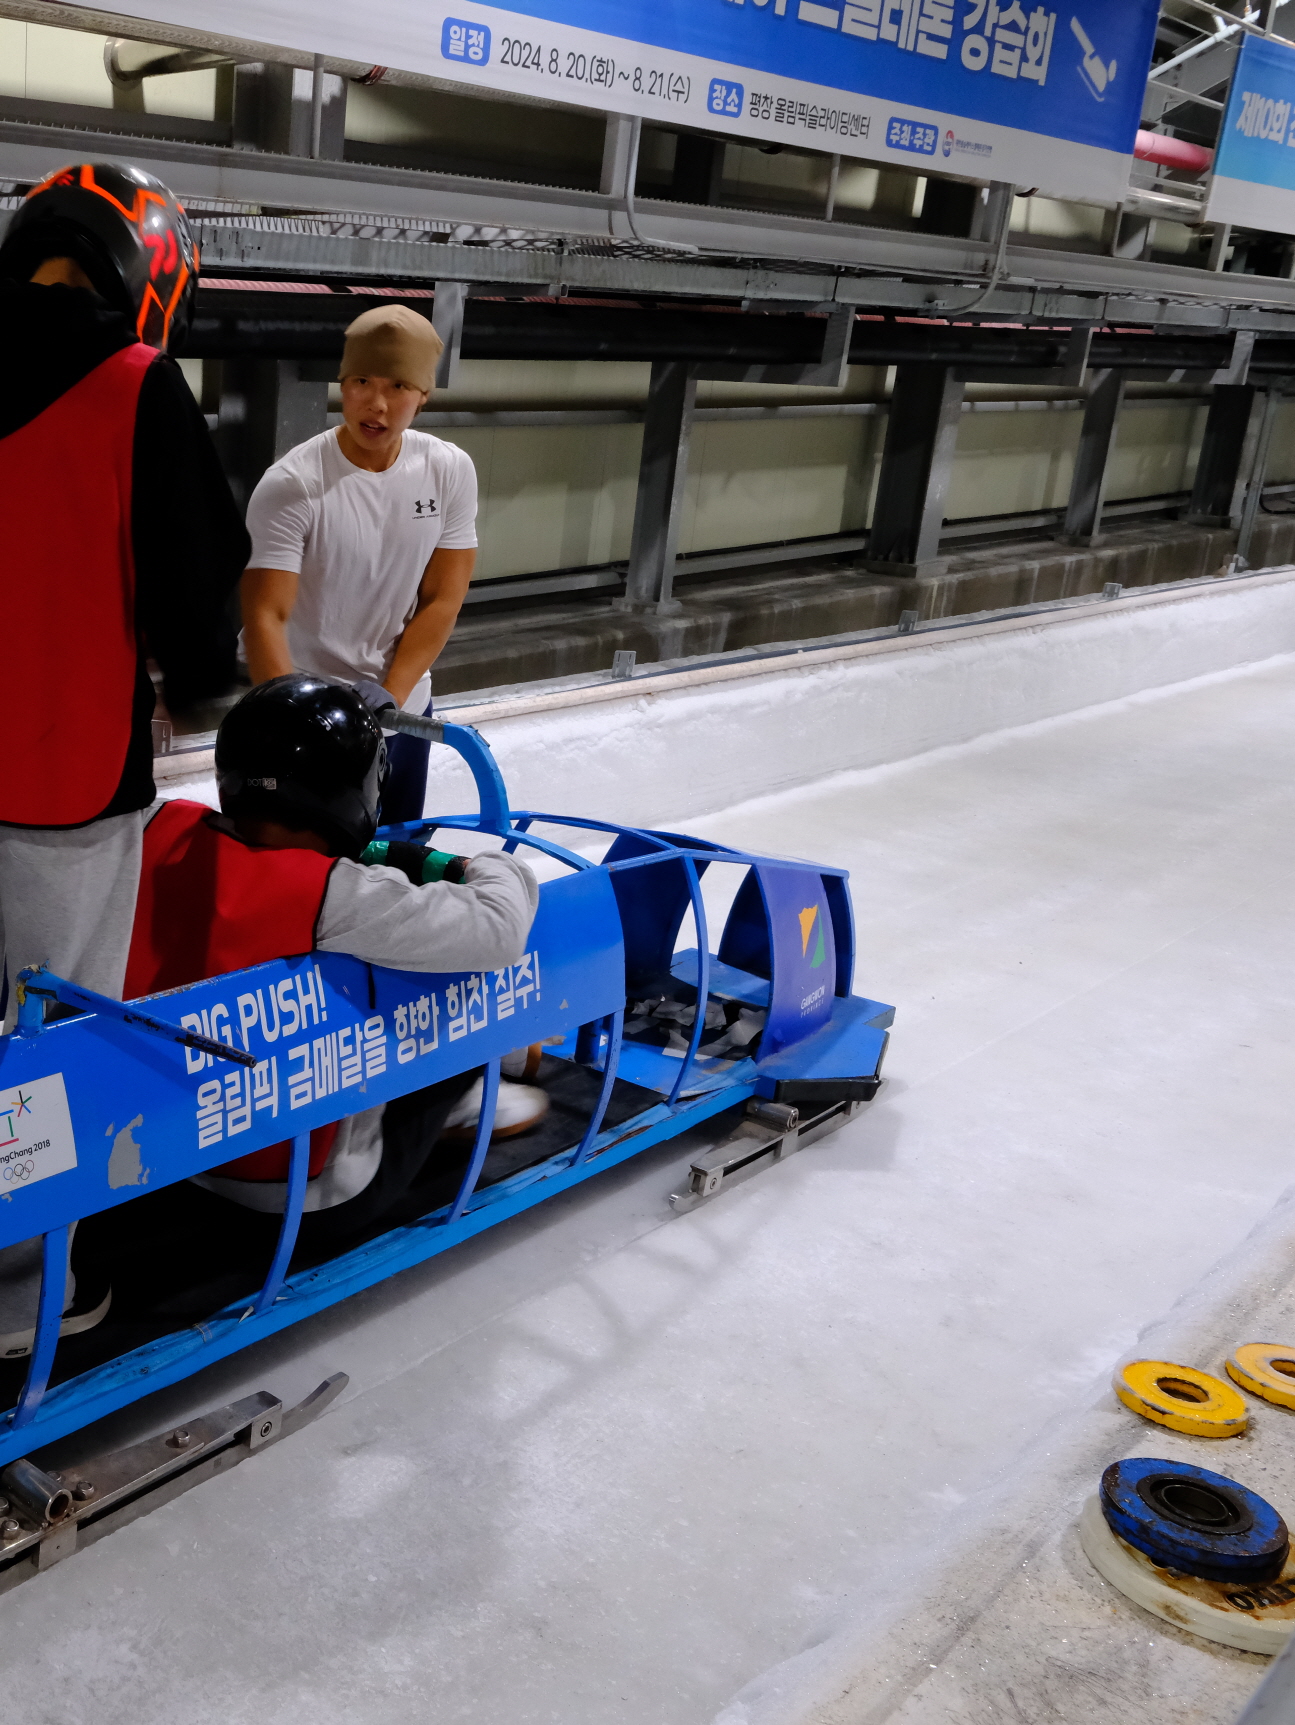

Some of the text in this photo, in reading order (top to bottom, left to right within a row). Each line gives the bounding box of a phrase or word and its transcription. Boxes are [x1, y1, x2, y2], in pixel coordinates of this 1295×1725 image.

[448, 24, 485, 61] 일정
[960, 0, 1057, 86] 강습회
[712, 84, 739, 113] 장소
[749, 92, 774, 121] 평창
[180, 964, 328, 1075] BIG PUSH!
[196, 950, 541, 1150] 올림픽 금메달을 향한 힘찬 질주!
[33, 1139, 51, 1152] 2018
